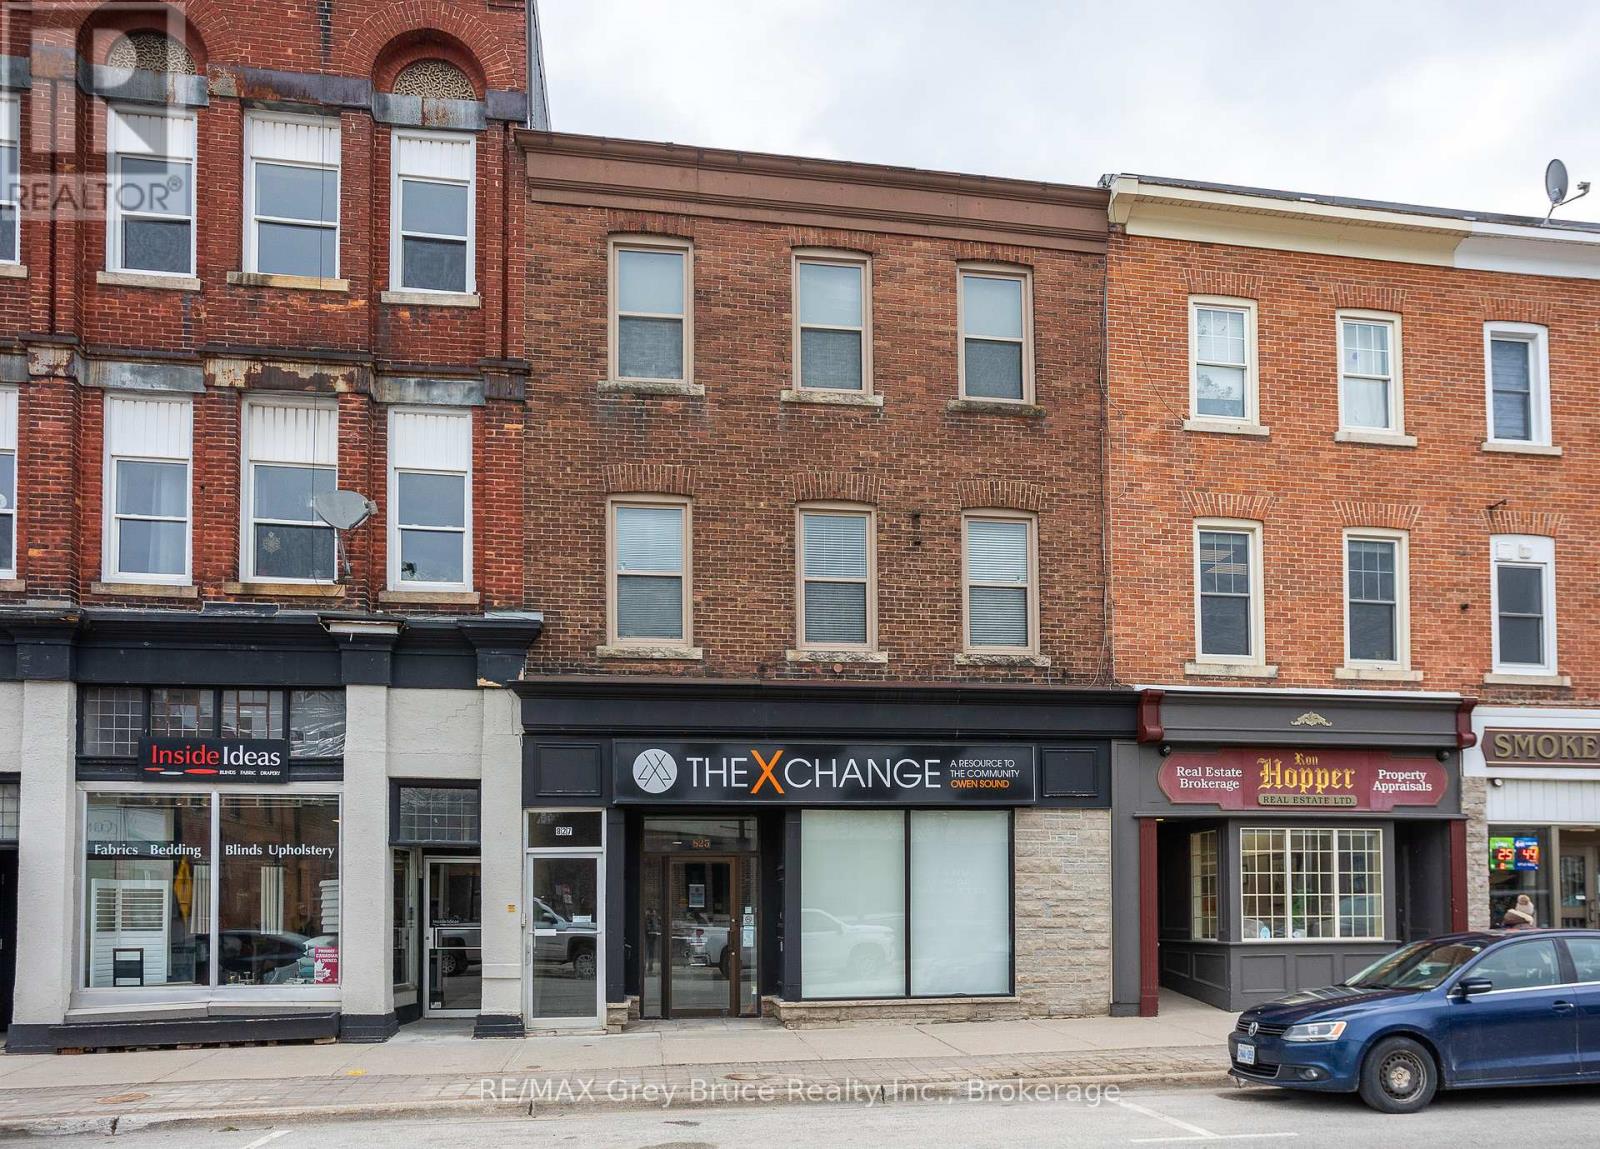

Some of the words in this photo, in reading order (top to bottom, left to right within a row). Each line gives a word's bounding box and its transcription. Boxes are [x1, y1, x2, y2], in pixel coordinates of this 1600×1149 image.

[1494, 734, 1600, 758] SMOKE
[152, 744, 219, 765] Inside
[223, 745, 281, 766] Ideas
[1295, 752, 1318, 765] Ron
[958, 760, 1002, 768] RESOURCE
[1004, 760, 1015, 768] TO
[950, 770, 965, 778] THE
[967, 770, 1020, 778] COMMUNITY
[1176, 766, 1202, 777] Real
[1205, 767, 1243, 777] Estate
[1257, 757, 1355, 794] Hopper
[1378, 769, 1427, 782] Property
[950, 780, 978, 788] OWEN
[979, 780, 1010, 788] SOUND
[1180, 779, 1240, 791] Brokerage
[1373, 781, 1432, 793] Appraisals
[1263, 796, 1289, 804] REAL
[1334, 797, 1355, 805] LTD.
[556, 827, 572, 835] 827
[94, 843, 138, 855] Fabrics
[150, 844, 202, 858] Bedding
[225, 844, 263, 855] Blinds
[268, 844, 335, 858] Upholstery
[1498, 848, 1513, 860] 25
